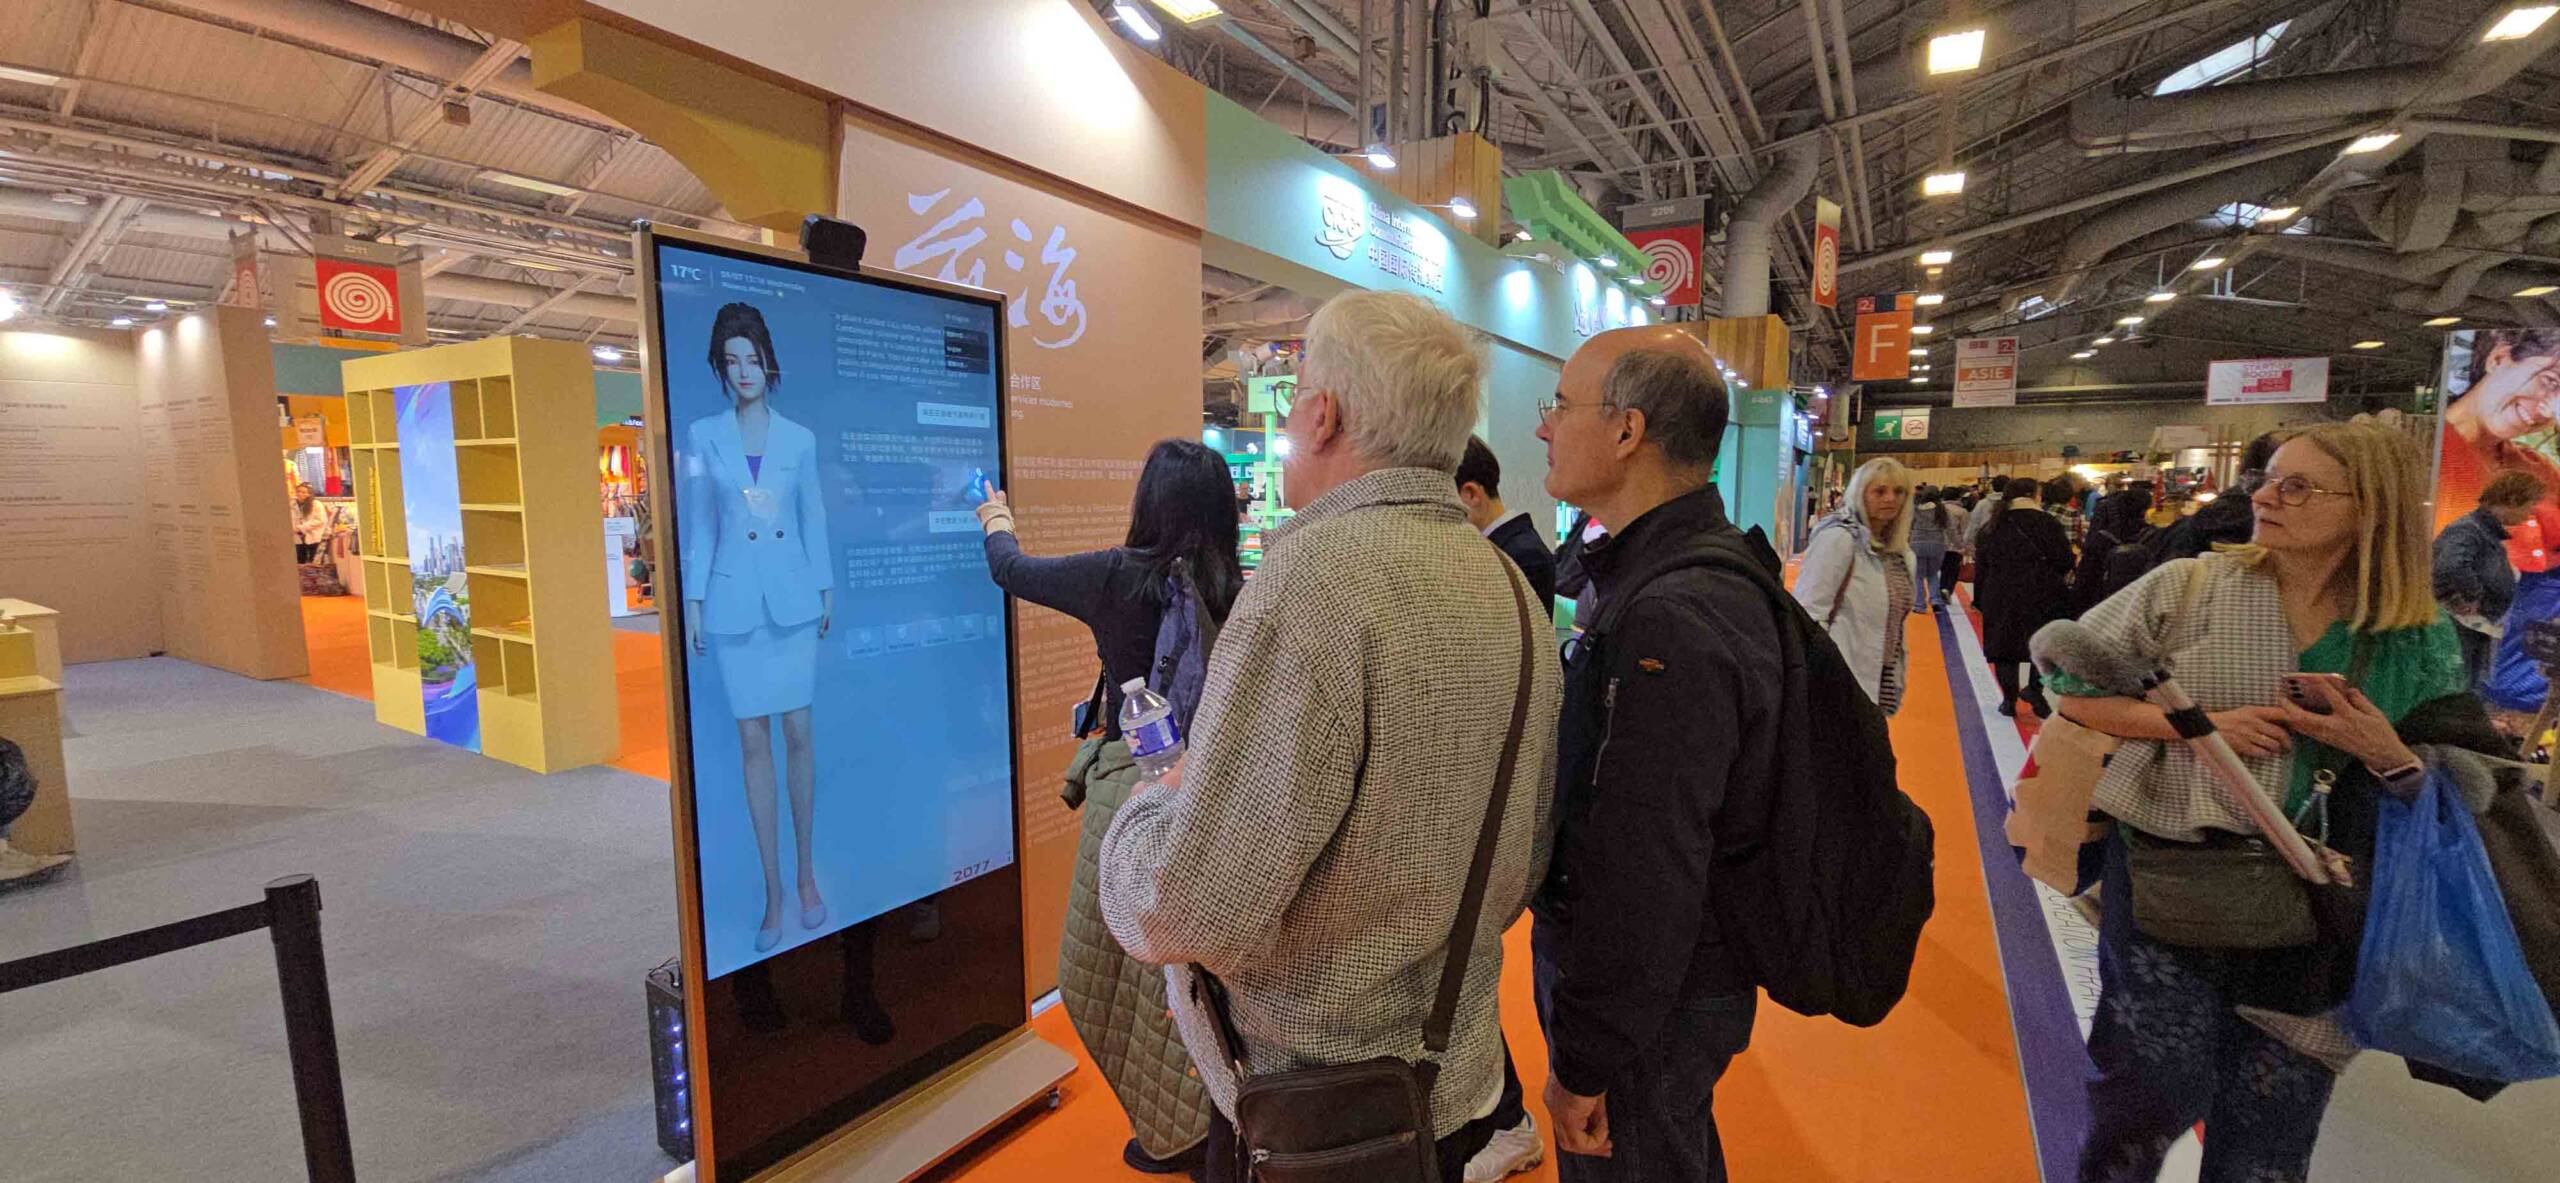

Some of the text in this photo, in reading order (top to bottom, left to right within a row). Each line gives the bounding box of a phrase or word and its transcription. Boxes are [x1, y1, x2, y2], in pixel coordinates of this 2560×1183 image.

[1869, 324, 1899, 363] F
[1010, 374, 1041, 390] 合作区
[1967, 368, 2004, 380] ASIE
[953, 859, 990, 882] 2077
